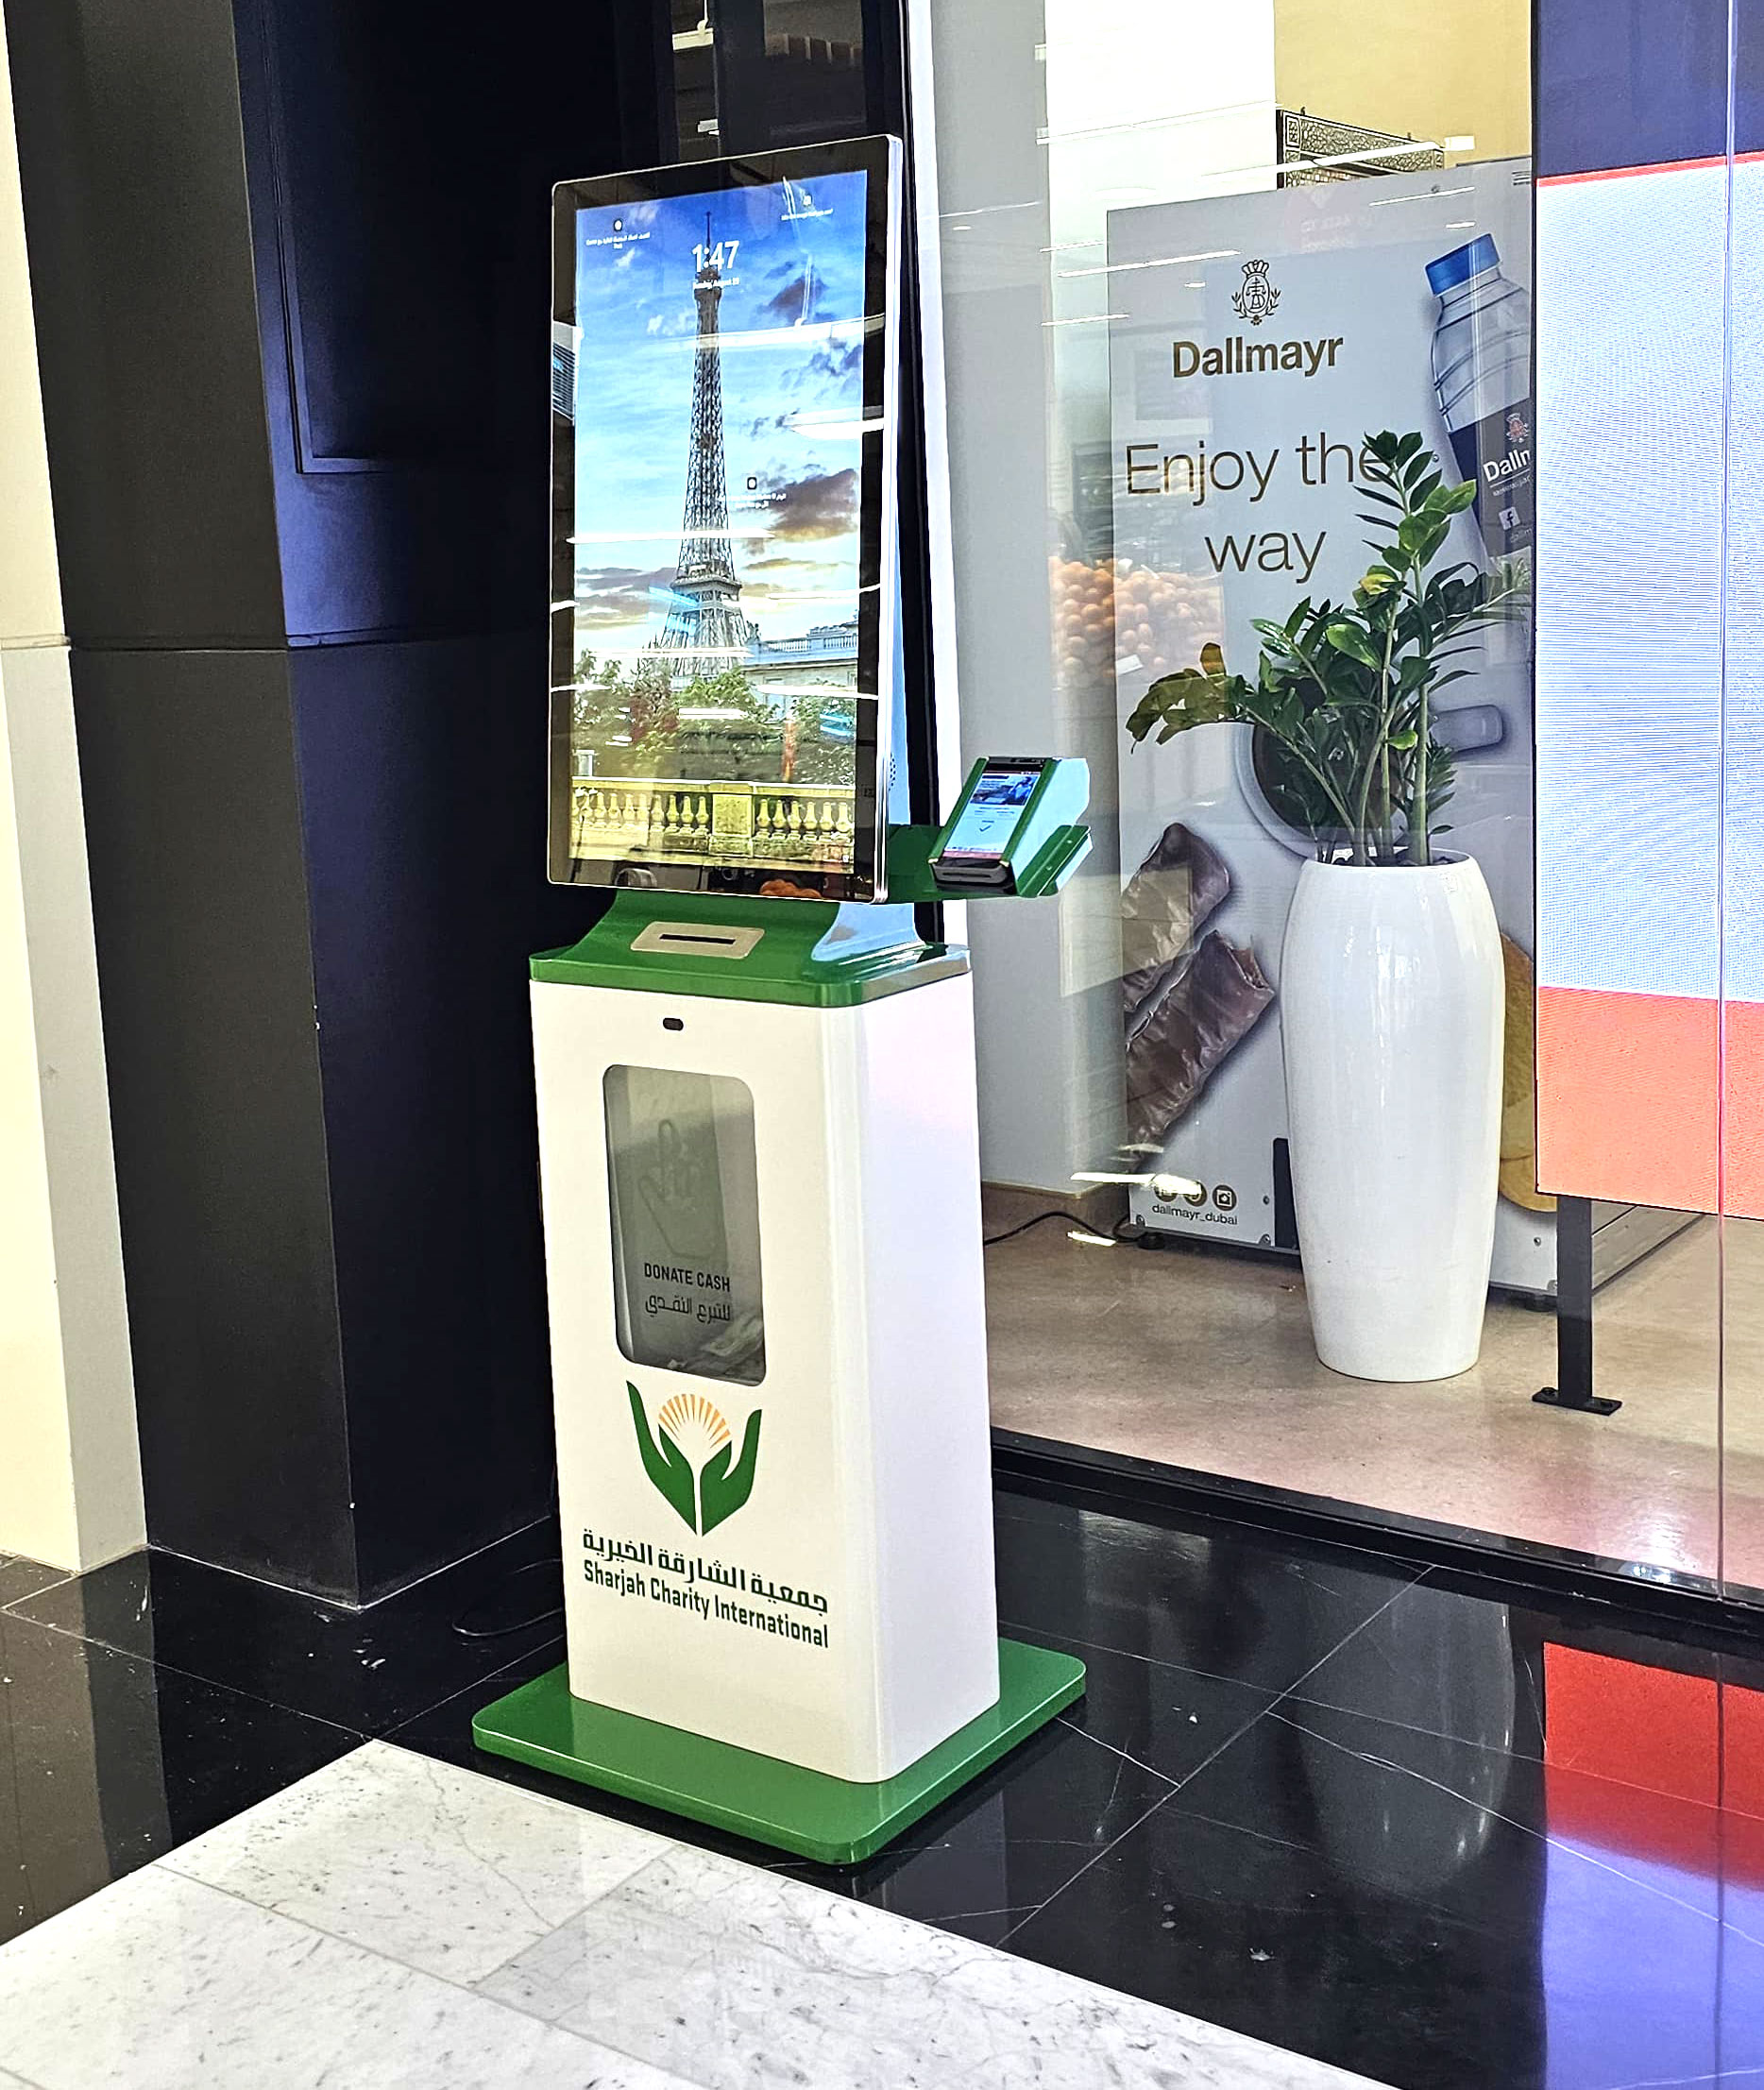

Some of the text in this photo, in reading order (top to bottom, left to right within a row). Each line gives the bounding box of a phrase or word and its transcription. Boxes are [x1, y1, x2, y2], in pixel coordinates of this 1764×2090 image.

[691, 240, 740, 273] 1:47
[1172, 335, 1344, 379] Dallmayr
[1125, 431, 1391, 507] Enjoy the
[1204, 530, 1327, 584] way
[1151, 1203, 1238, 1226] dallmayr_dubai
[644, 1262, 731, 1293] DONATE CASH
[645, 1295, 731, 1324] للتبرع النقدي
[583, 1528, 828, 1617] جمعية الشارقة الخيرية
[584, 1559, 829, 1649] Sharjah Charity International
